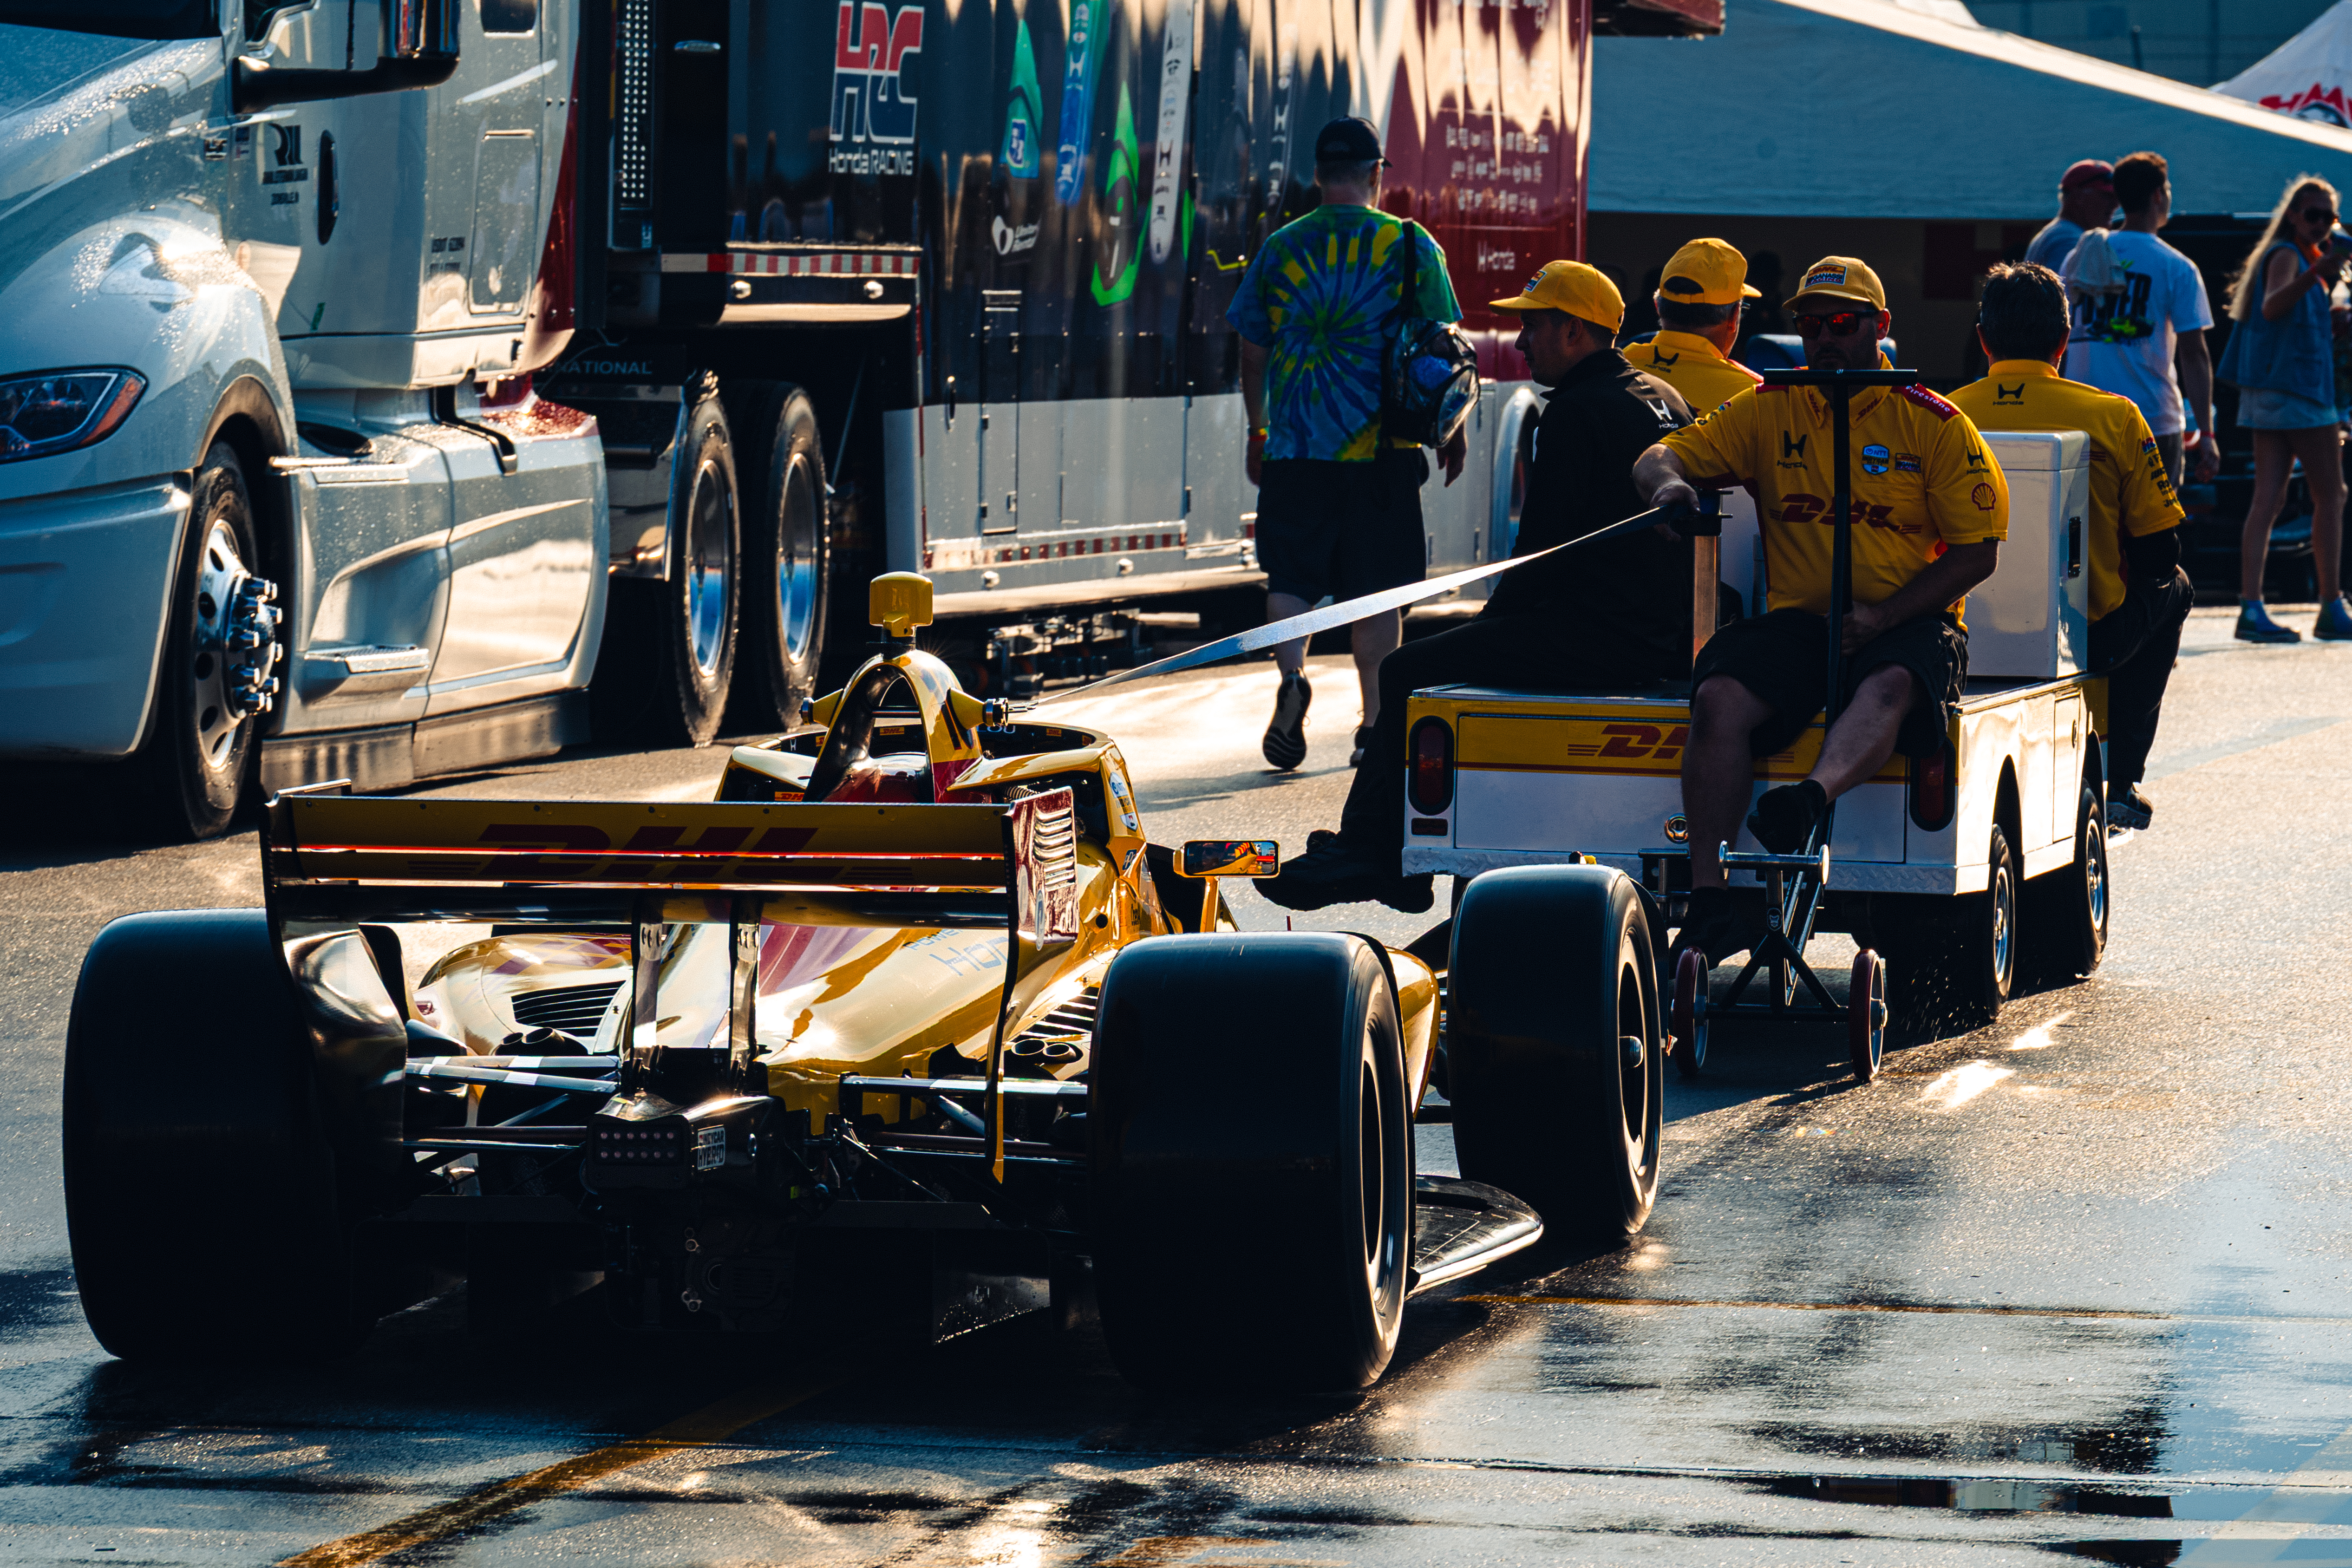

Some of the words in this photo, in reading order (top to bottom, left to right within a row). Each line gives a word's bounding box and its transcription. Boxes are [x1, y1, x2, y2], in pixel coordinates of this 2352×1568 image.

[829, 148, 869, 174] Honda
[871, 149, 914, 176] RACING
[1906, 385, 1950, 412] Firestone
[1598, 724, 1690, 759] DH
[477, 824, 844, 879] DHL
[902, 928, 964, 950] POWE
[698, 1144, 725, 1167] HYBRID
